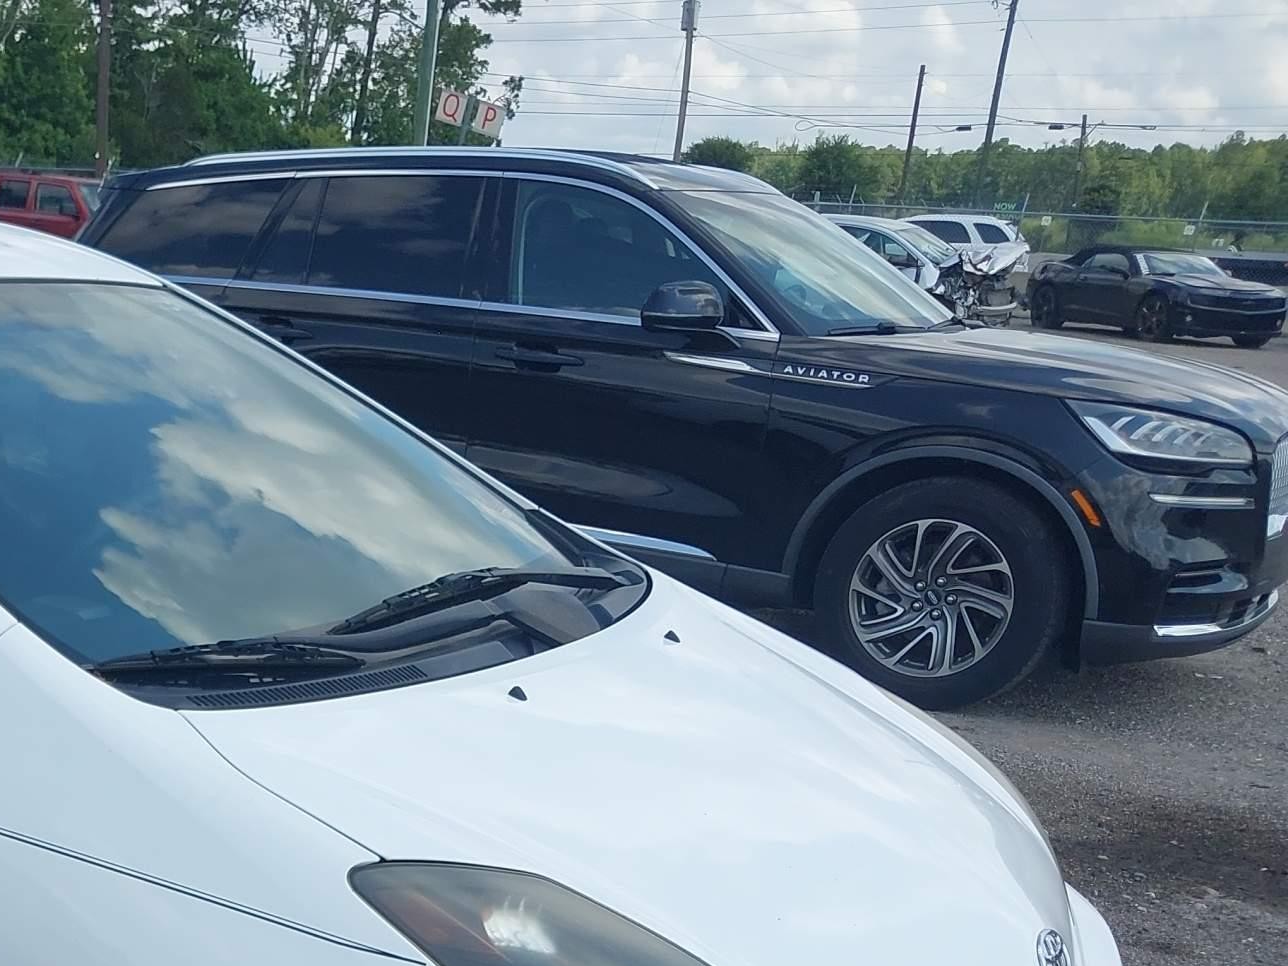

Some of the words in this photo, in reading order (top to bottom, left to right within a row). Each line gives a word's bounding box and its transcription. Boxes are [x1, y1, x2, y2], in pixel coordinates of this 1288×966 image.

[443, 93, 460, 123] Q
[481, 106, 497, 130] P
[993, 202, 1017, 212] NOW
[783, 365, 870, 384] AVIATOR
